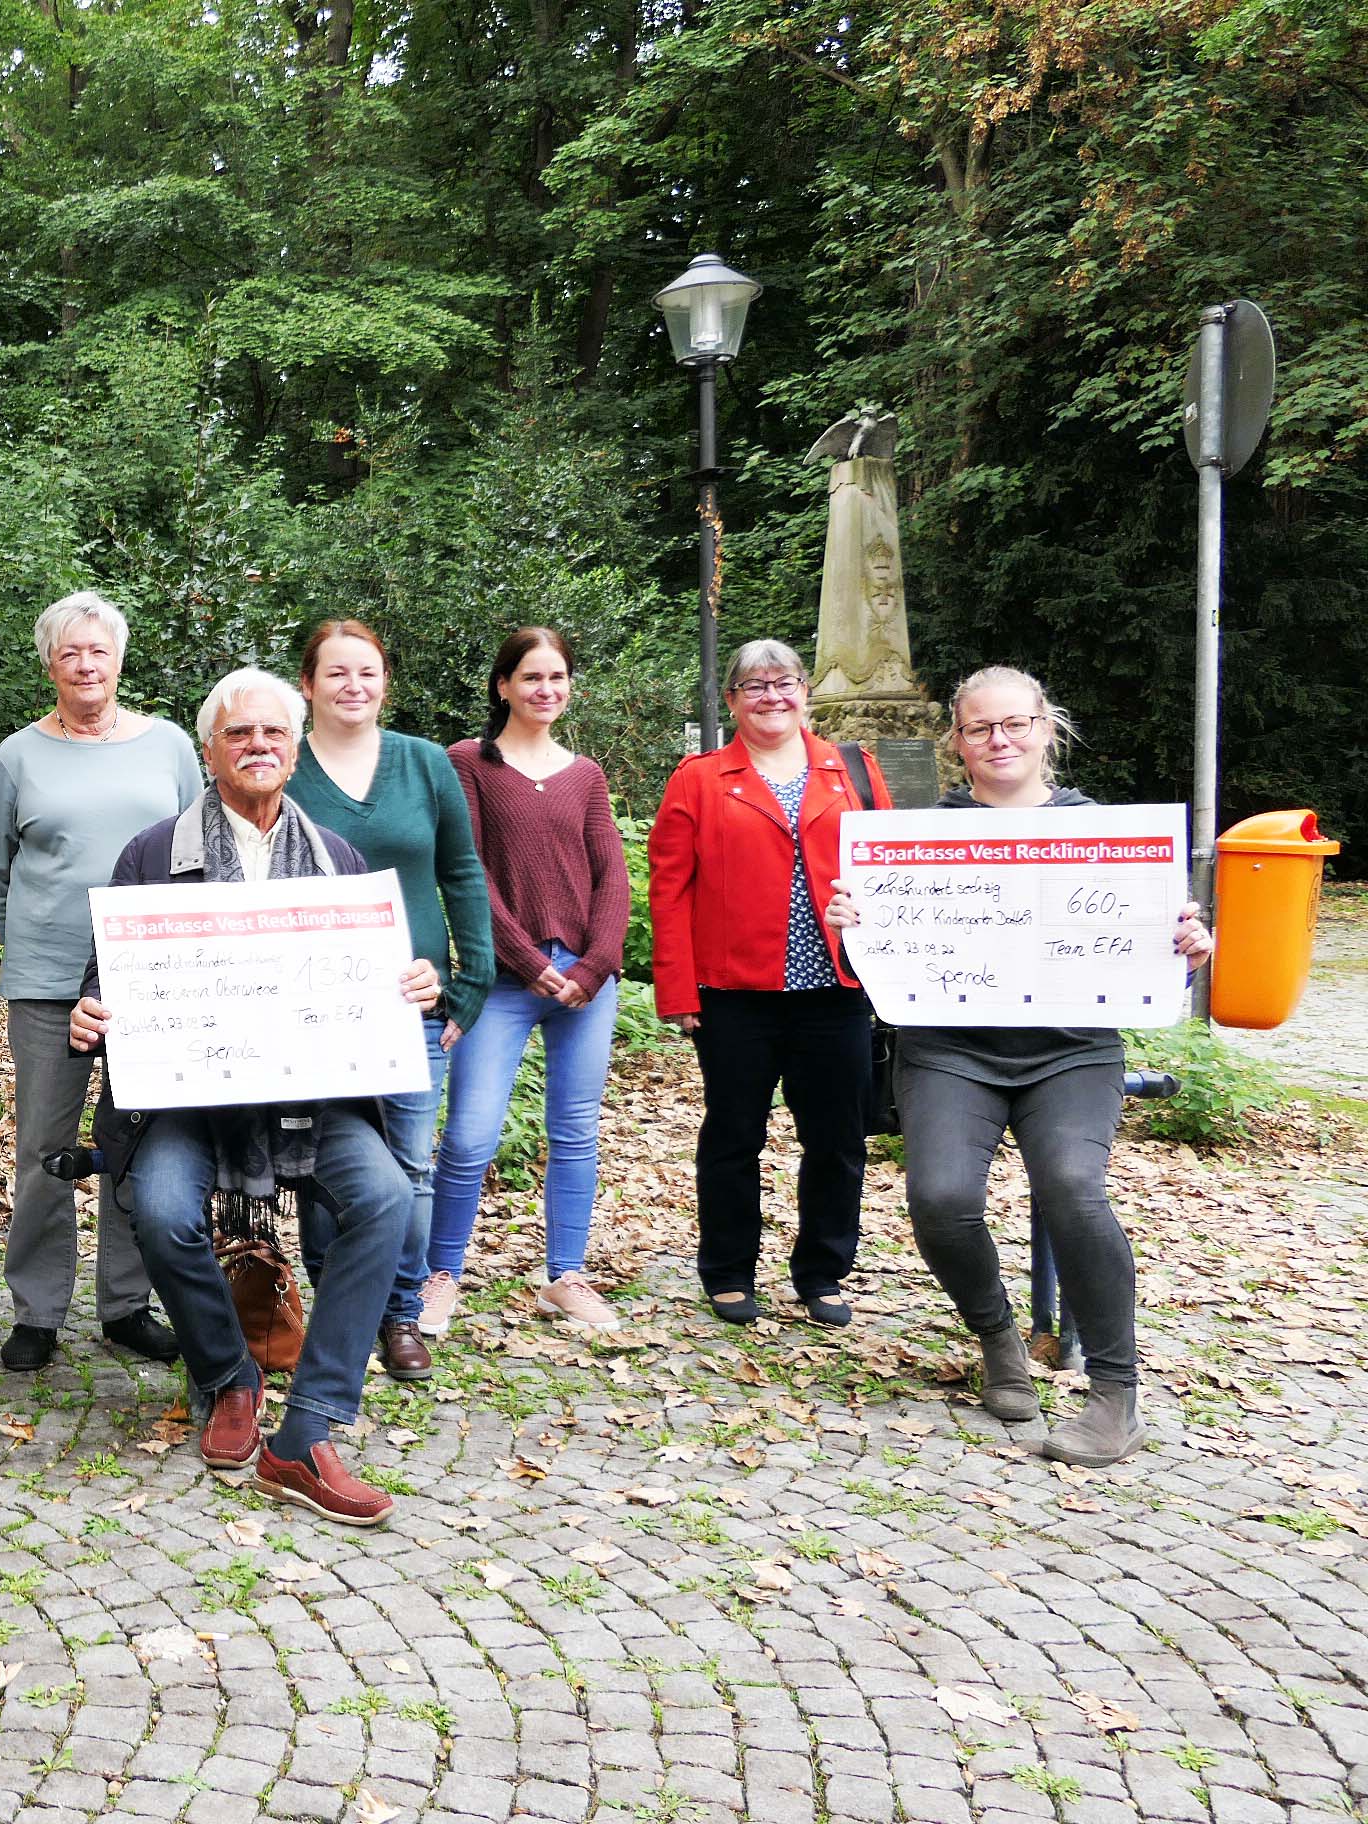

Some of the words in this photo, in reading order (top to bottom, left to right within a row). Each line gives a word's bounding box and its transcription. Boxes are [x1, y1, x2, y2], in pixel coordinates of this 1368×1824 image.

[873, 845, 966, 864] Sparkasse
[969, 845, 1011, 860] Vest
[1016, 842, 1170, 862] Recklinghausen
[1067, 887, 1130, 919] 660,-
[126, 917, 213, 939] Sparkasse
[216, 916, 254, 931] Vest
[257, 909, 391, 930] Recklinghausen
[874, 905, 925, 928] DRK
[1044, 939, 1086, 957] Team
[1093, 936, 1133, 956] EFA
[925, 962, 998, 993] Spende
[291, 1007, 328, 1025] Team
[186, 1040, 261, 1069] Spende
